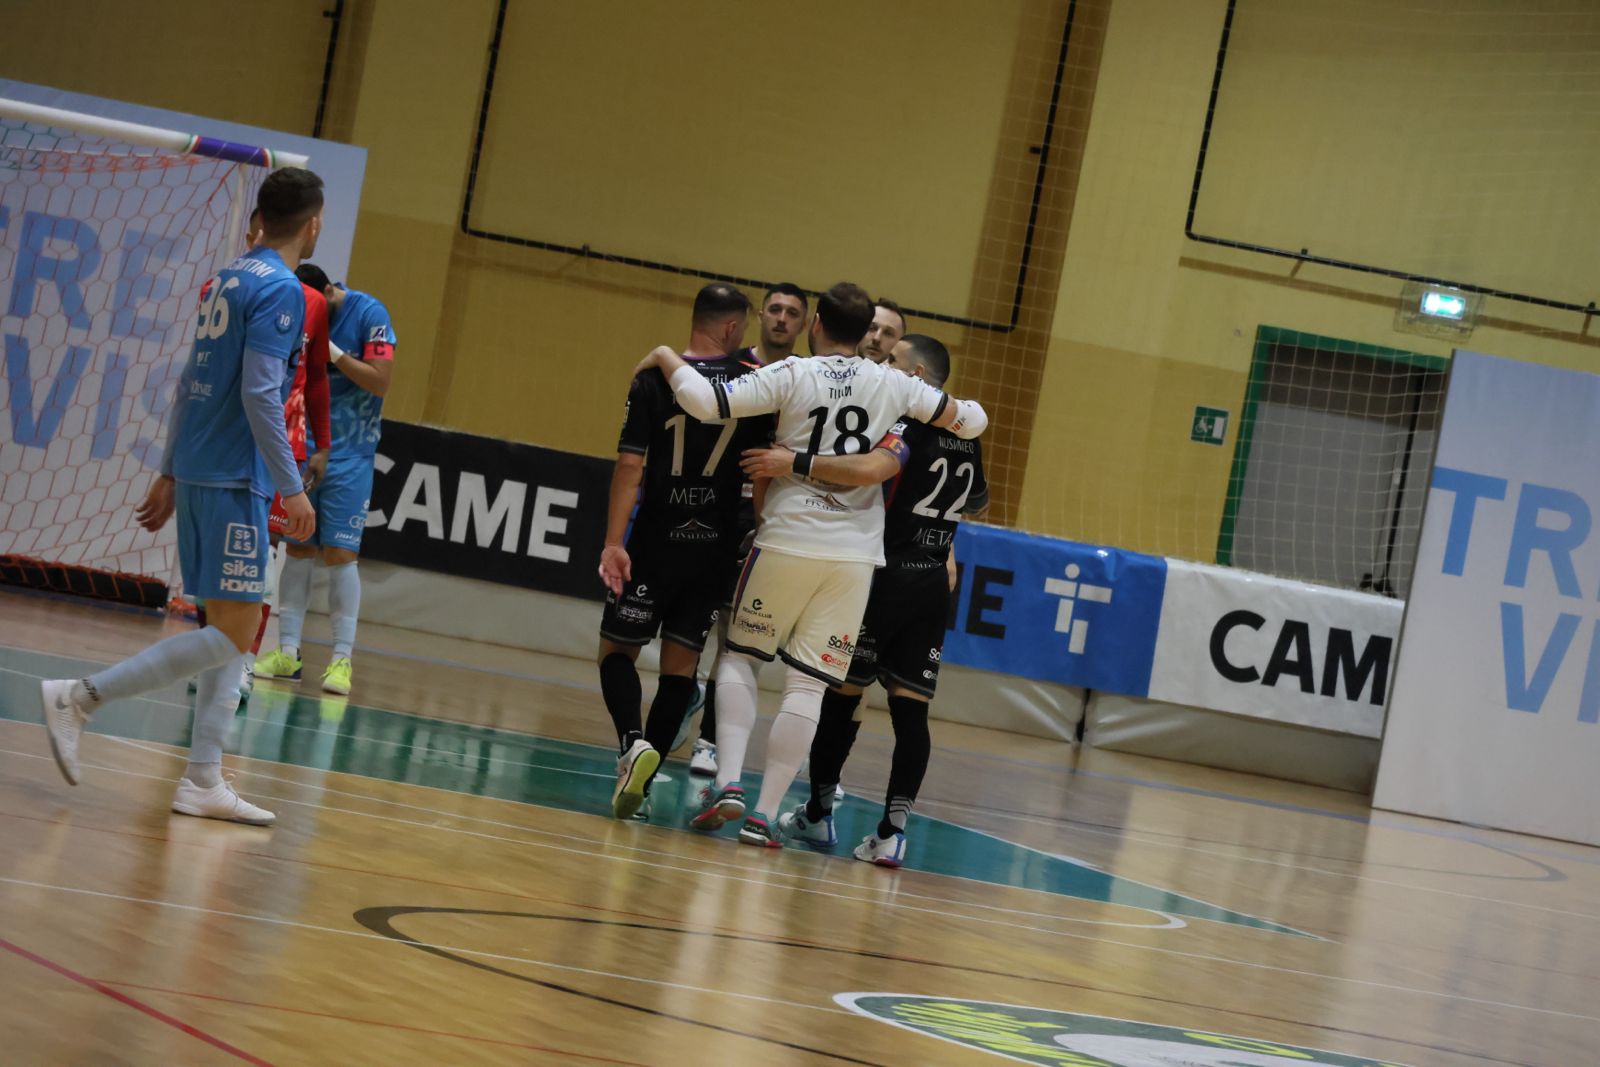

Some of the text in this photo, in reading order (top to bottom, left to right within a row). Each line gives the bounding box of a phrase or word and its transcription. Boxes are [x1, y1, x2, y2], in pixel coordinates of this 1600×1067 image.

[664, 414, 738, 477] 17
[807, 404, 871, 456] 18
[669, 487, 716, 505] META
[912, 457, 975, 522] 22
[234, 529, 251, 540] SP
[243, 541, 251, 551] S
